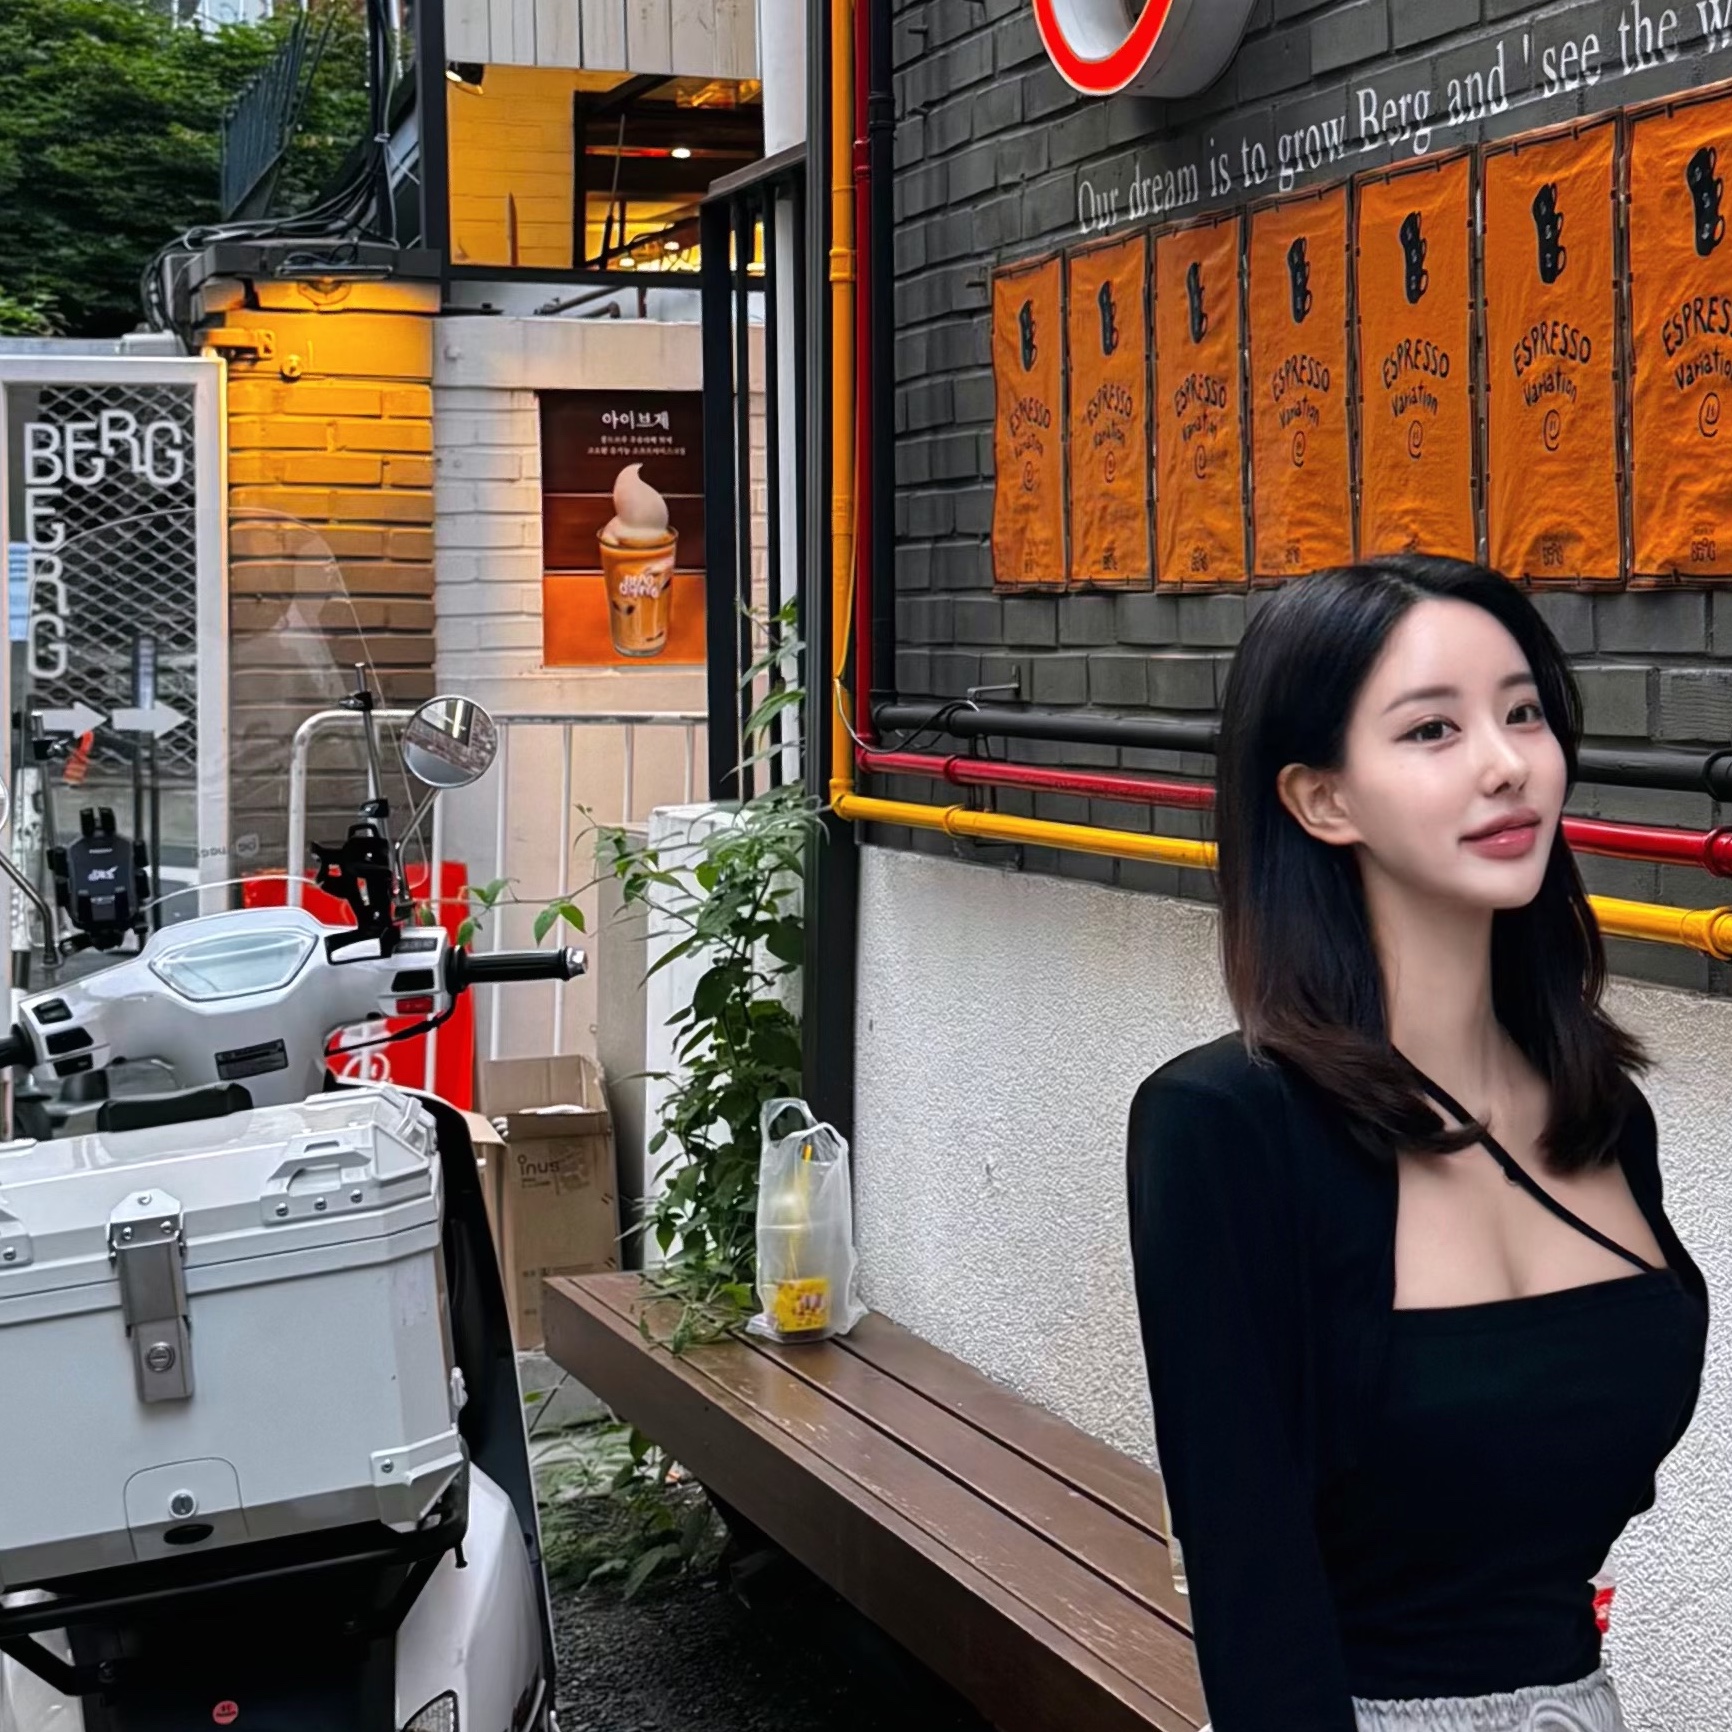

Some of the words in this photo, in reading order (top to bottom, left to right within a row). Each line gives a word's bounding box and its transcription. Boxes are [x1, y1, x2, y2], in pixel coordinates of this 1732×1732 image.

[1079, 181, 1119, 234] Our
[1129, 161, 1199, 220] dream
[1210, 138, 1231, 197] is
[1242, 132, 1266, 188] to
[1278, 114, 1348, 192] grow
[1357, 87, 1431, 155] Berg
[1447, 64, 1509, 125] and
[1618, 0, 1679, 76] the
[1383, 338, 1450, 390] ESPRESSO
[1513, 320, 1592, 378] ESPRESSO
[1272, 354, 1330, 403] ESPRESSO
[24, 409, 184, 486] BERG
